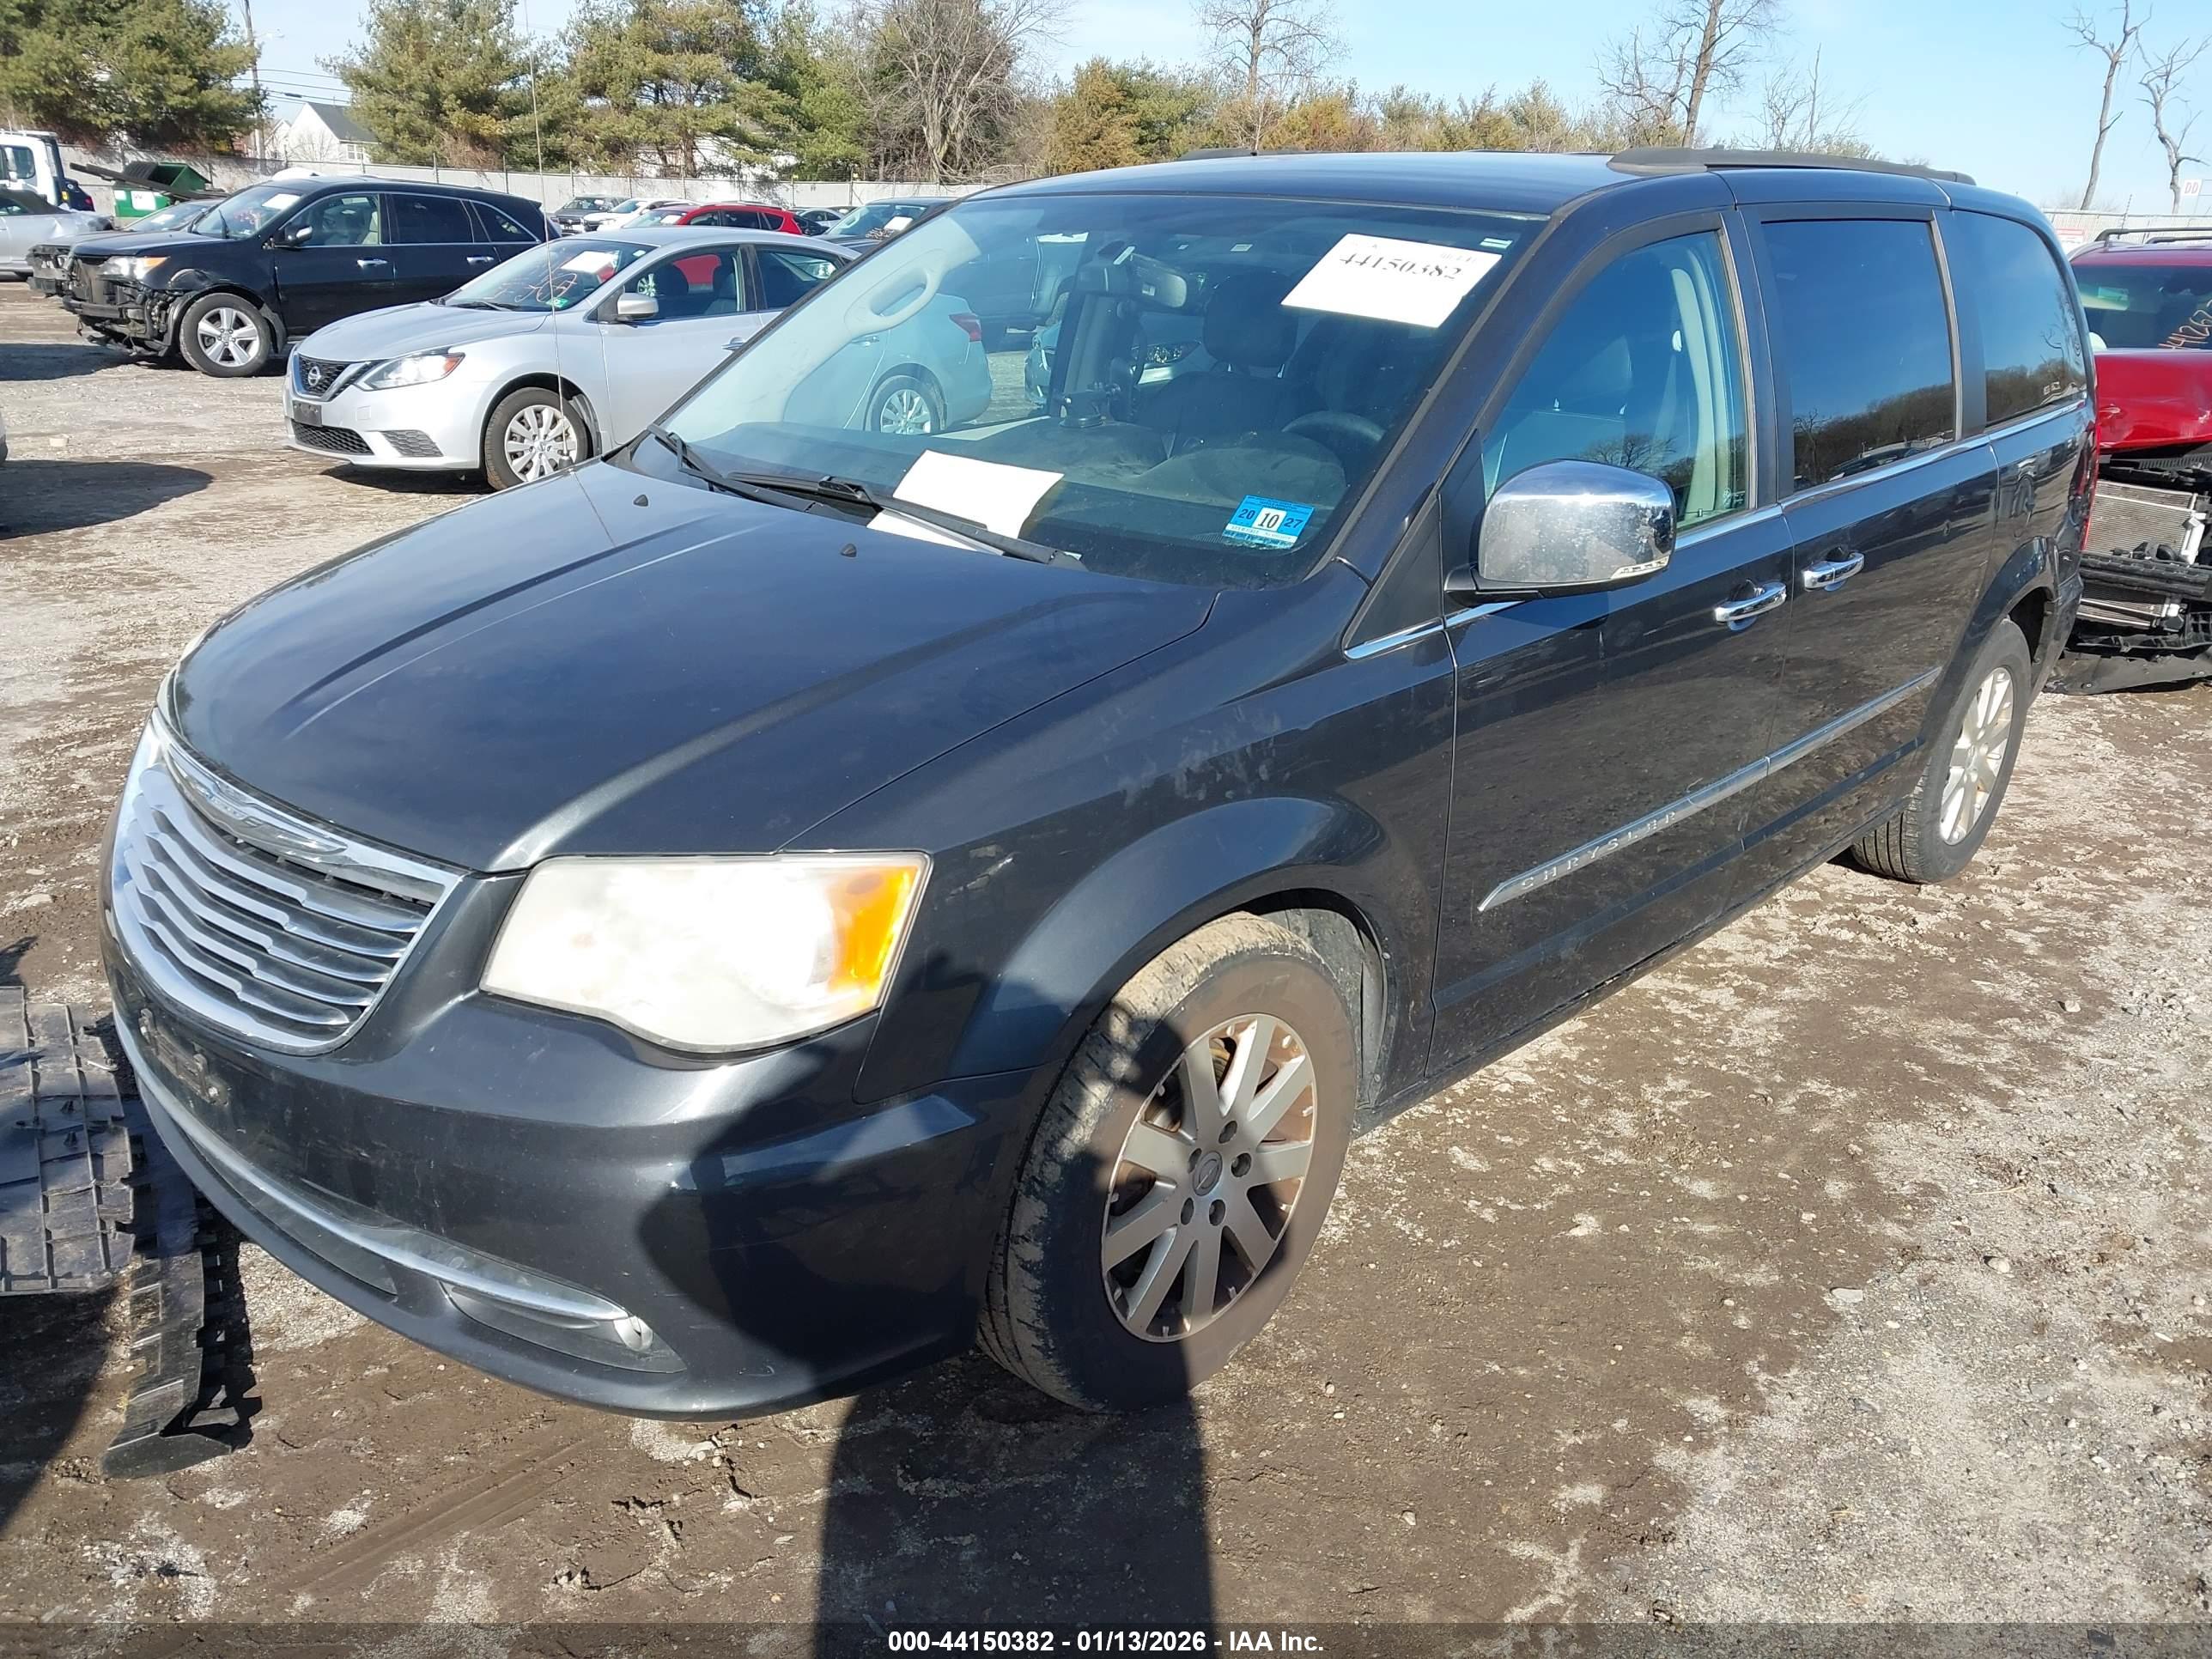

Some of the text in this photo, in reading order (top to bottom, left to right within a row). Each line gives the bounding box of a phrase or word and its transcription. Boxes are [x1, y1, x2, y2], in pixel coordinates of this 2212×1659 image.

[1339, 252, 1462, 280] 44150382
[1238, 508, 1304, 529] 20 10 27
[1520, 810, 1676, 890] CHRYSLER
